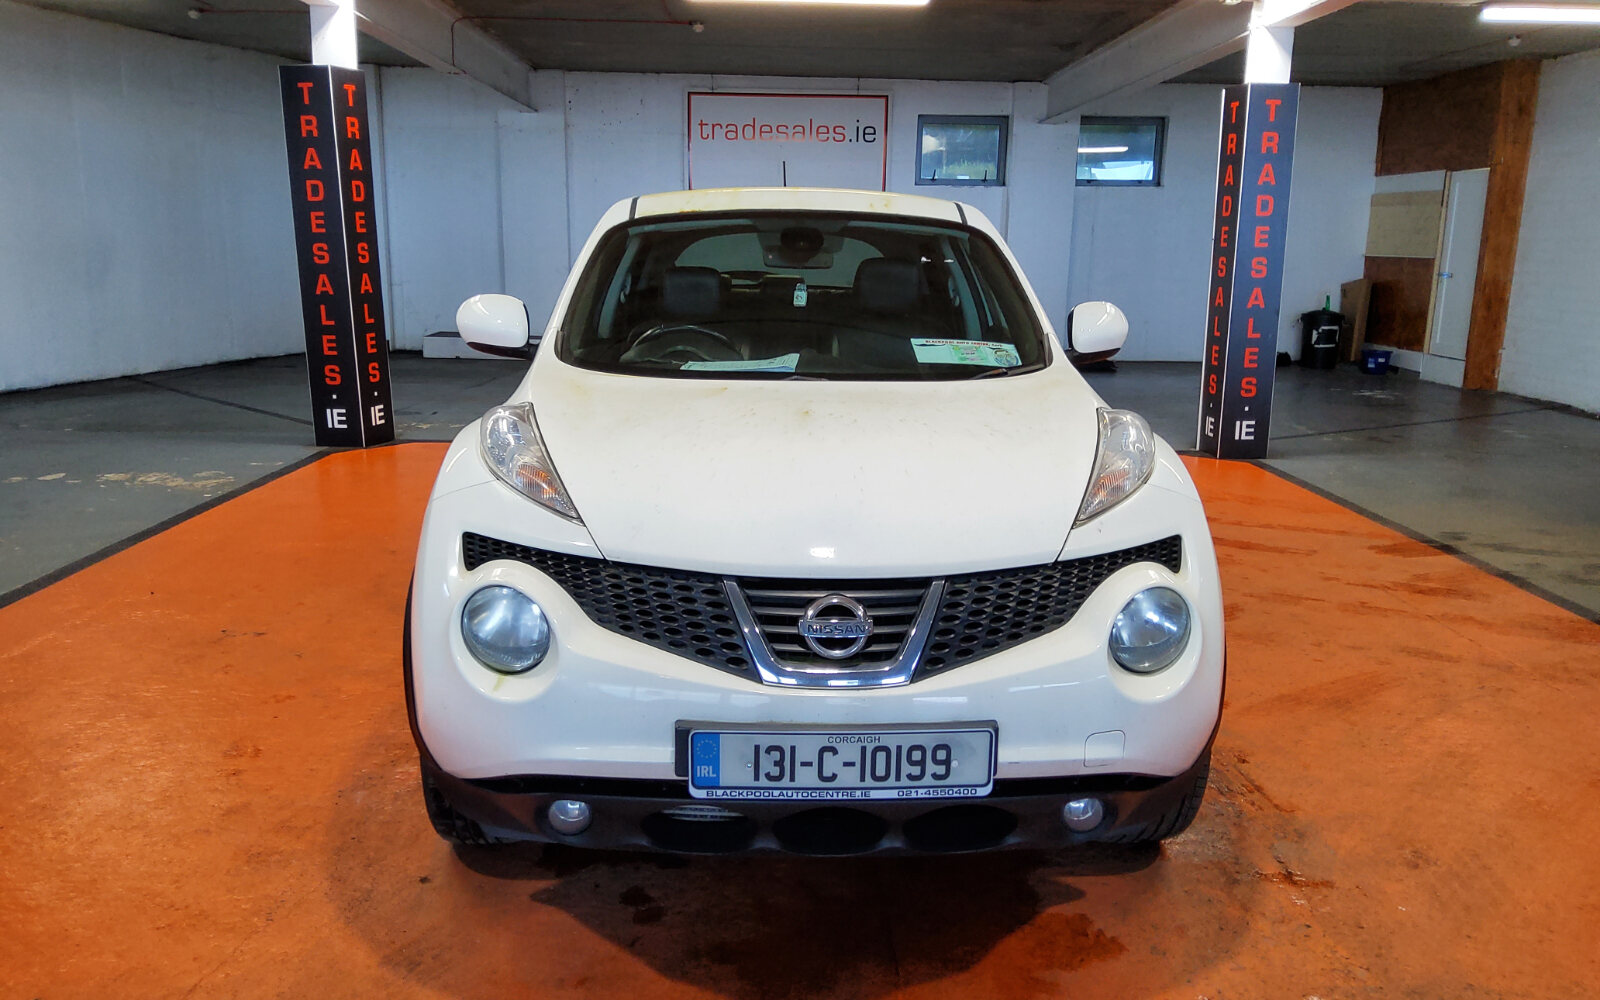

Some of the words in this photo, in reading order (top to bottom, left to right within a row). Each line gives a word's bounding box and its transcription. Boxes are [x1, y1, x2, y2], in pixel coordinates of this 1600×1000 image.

[698, 117, 877, 143] tradesales.ie
[807, 624, 866, 634] NISSAN
[827, 735, 881, 744] CORCAIGH
[753, 744, 952, 782] 131-C-10199
[696, 765, 717, 778] IRL
[706, 790, 872, 798] BLACKPOOLAUTOCENTRE.IE
